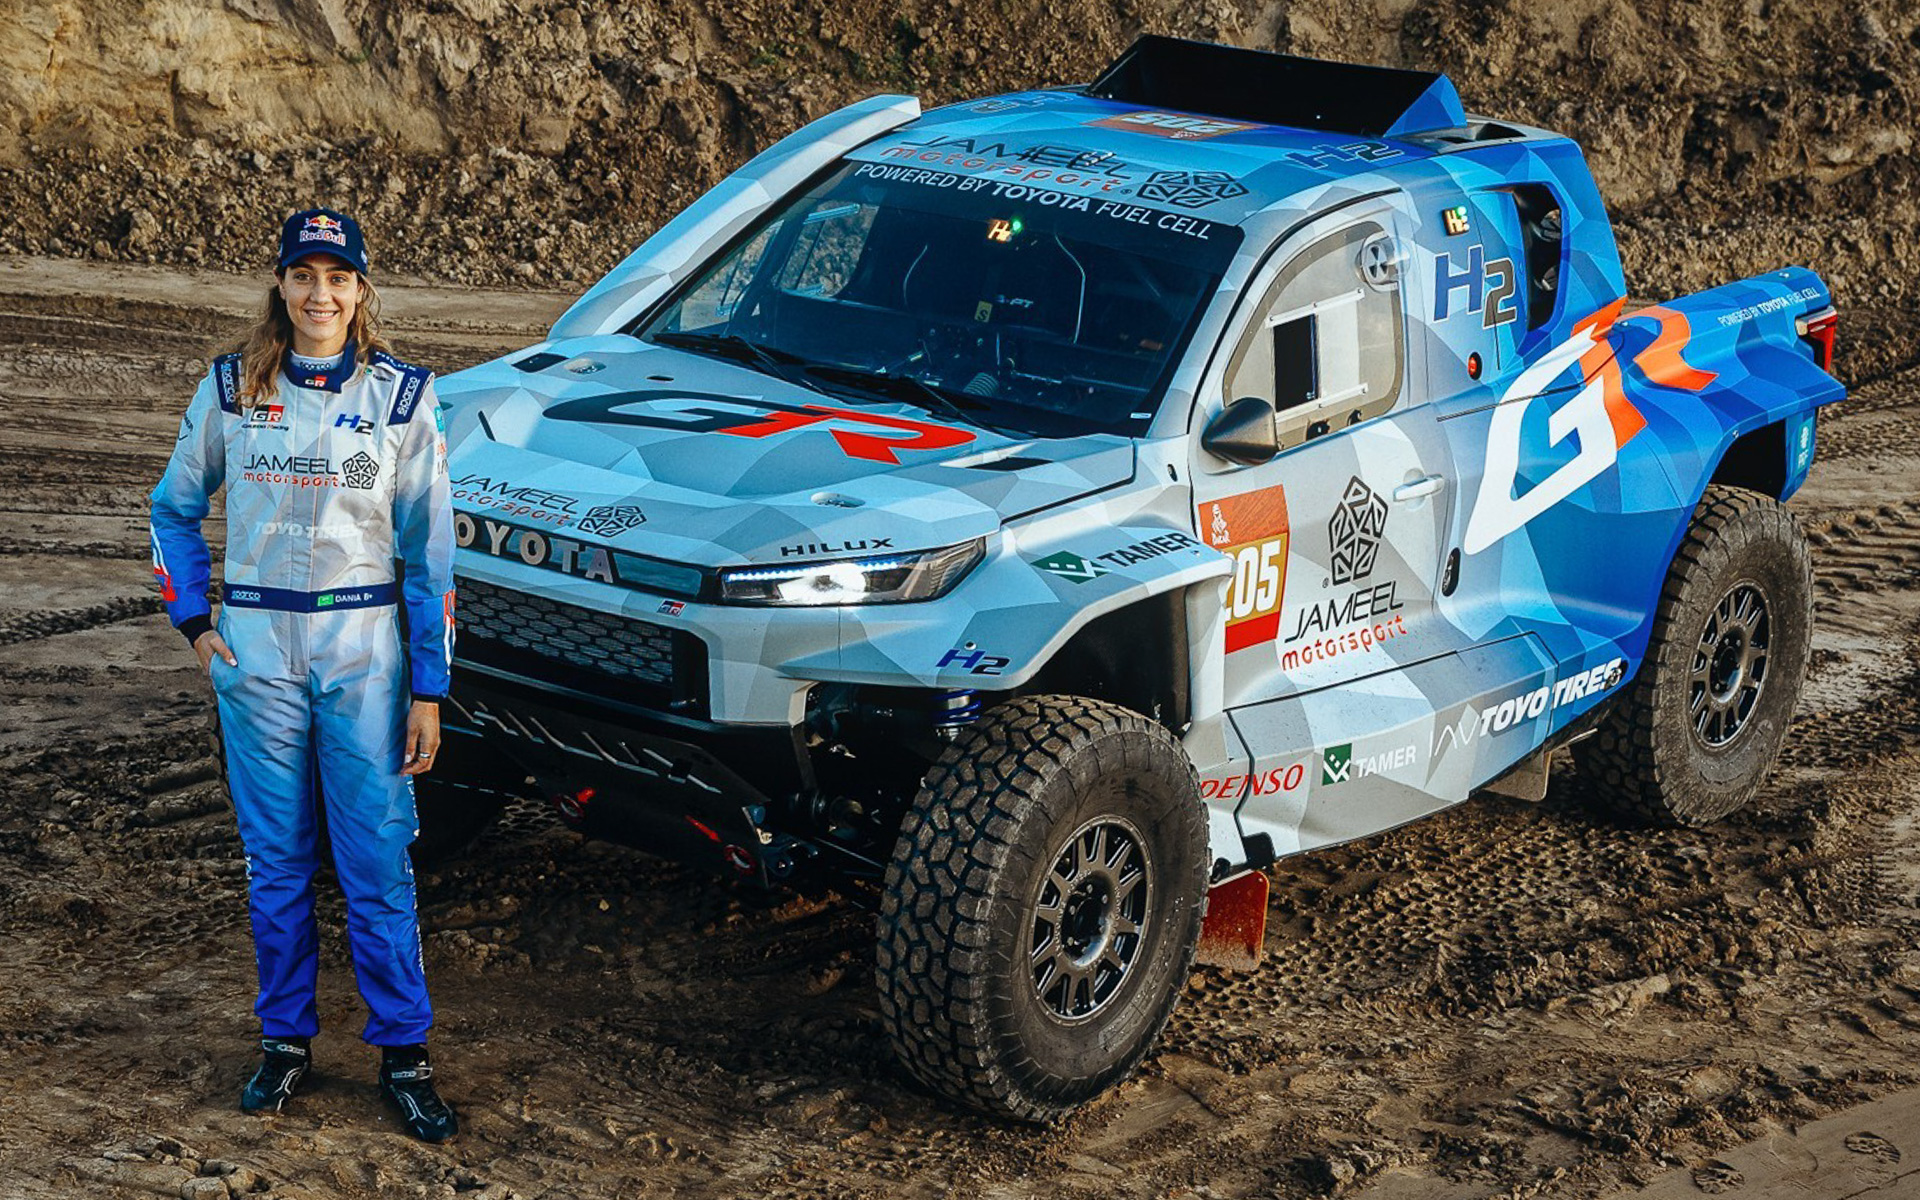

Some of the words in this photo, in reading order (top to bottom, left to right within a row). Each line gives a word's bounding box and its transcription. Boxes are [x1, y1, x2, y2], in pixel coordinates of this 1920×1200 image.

[880, 147, 1122, 193] motorsport
[900, 134, 1132, 180] JAMEEL
[1285, 141, 1405, 170] H2
[854, 163, 959, 189] POWERED
[958, 176, 991, 195] BY
[992, 181, 1091, 212] TOYOTA
[1096, 202, 1152, 226] FUEL
[1157, 214, 1212, 240] CELL
[299, 229, 323, 242] Red
[323, 230, 346, 247] Bull
[1433, 244, 1518, 329] H2
[1717, 309, 1753, 328] POWERED
[1749, 306, 1761, 318] BY
[1757, 296, 1791, 314] TOYOTA
[1786, 292, 1806, 307] FUEL
[1802, 287, 1821, 300] CELL
[253, 410, 283, 422] GR
[397, 377, 421, 417] sparco
[334, 413, 376, 436] H2
[541, 389, 978, 466] GR
[1463, 295, 1720, 555] GR
[243, 453, 339, 475] JAMEEL
[243, 471, 339, 488] motorsport
[450, 473, 580, 515] JAMEEL
[451, 487, 572, 527] otorsport
[455, 512, 614, 584] OYOTA
[780, 536, 895, 558] HILUX
[1096, 532, 1200, 567] TAMER
[334, 593, 362, 603] DANIA
[1284, 580, 1404, 643] JAMEEL
[935, 648, 1011, 676] H2
[1282, 614, 1408, 671] motorsport
[1479, 686, 1550, 738] TOYO
[1199, 763, 1304, 799] DENSO
[1355, 745, 1417, 778] TAMER
